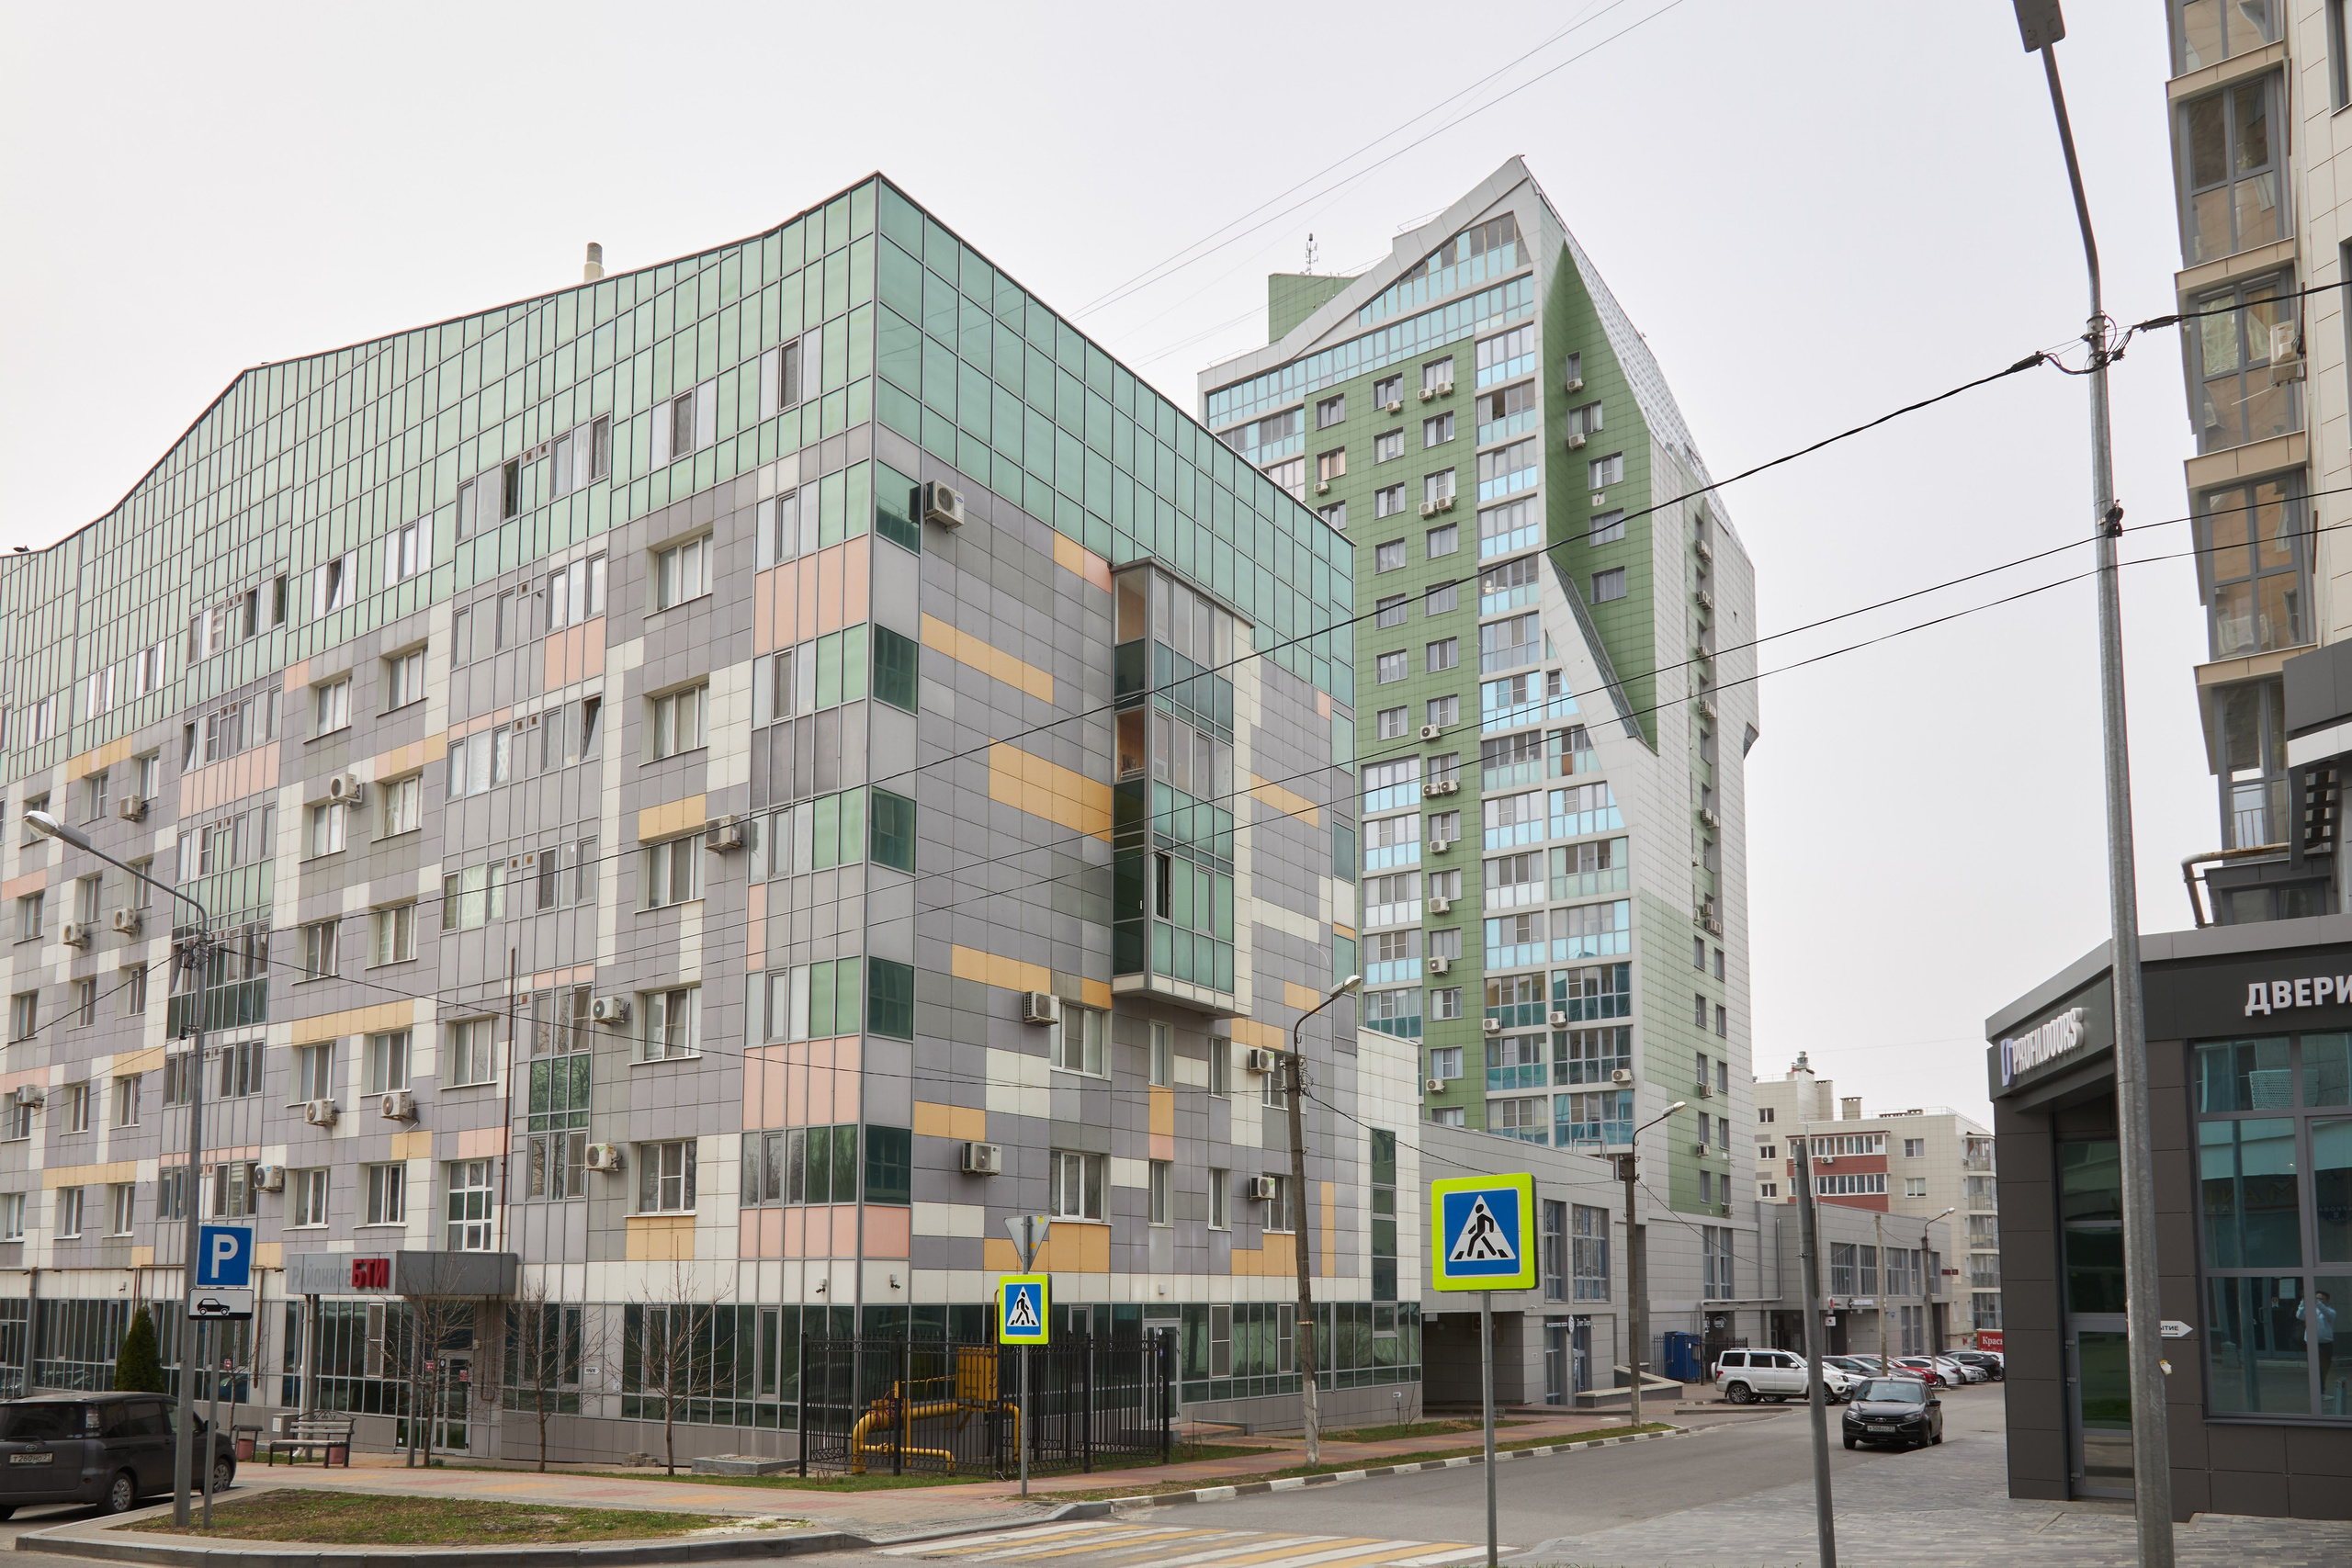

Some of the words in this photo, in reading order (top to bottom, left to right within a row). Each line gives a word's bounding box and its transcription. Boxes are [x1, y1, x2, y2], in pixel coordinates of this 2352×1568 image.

[2245, 975, 2352, 1016] ДВЕРИ
[2013, 1008, 2084, 1075] PROFILDOORS
[210, 1234, 239, 1279] P
[351, 1258, 390, 1288] БТИ
